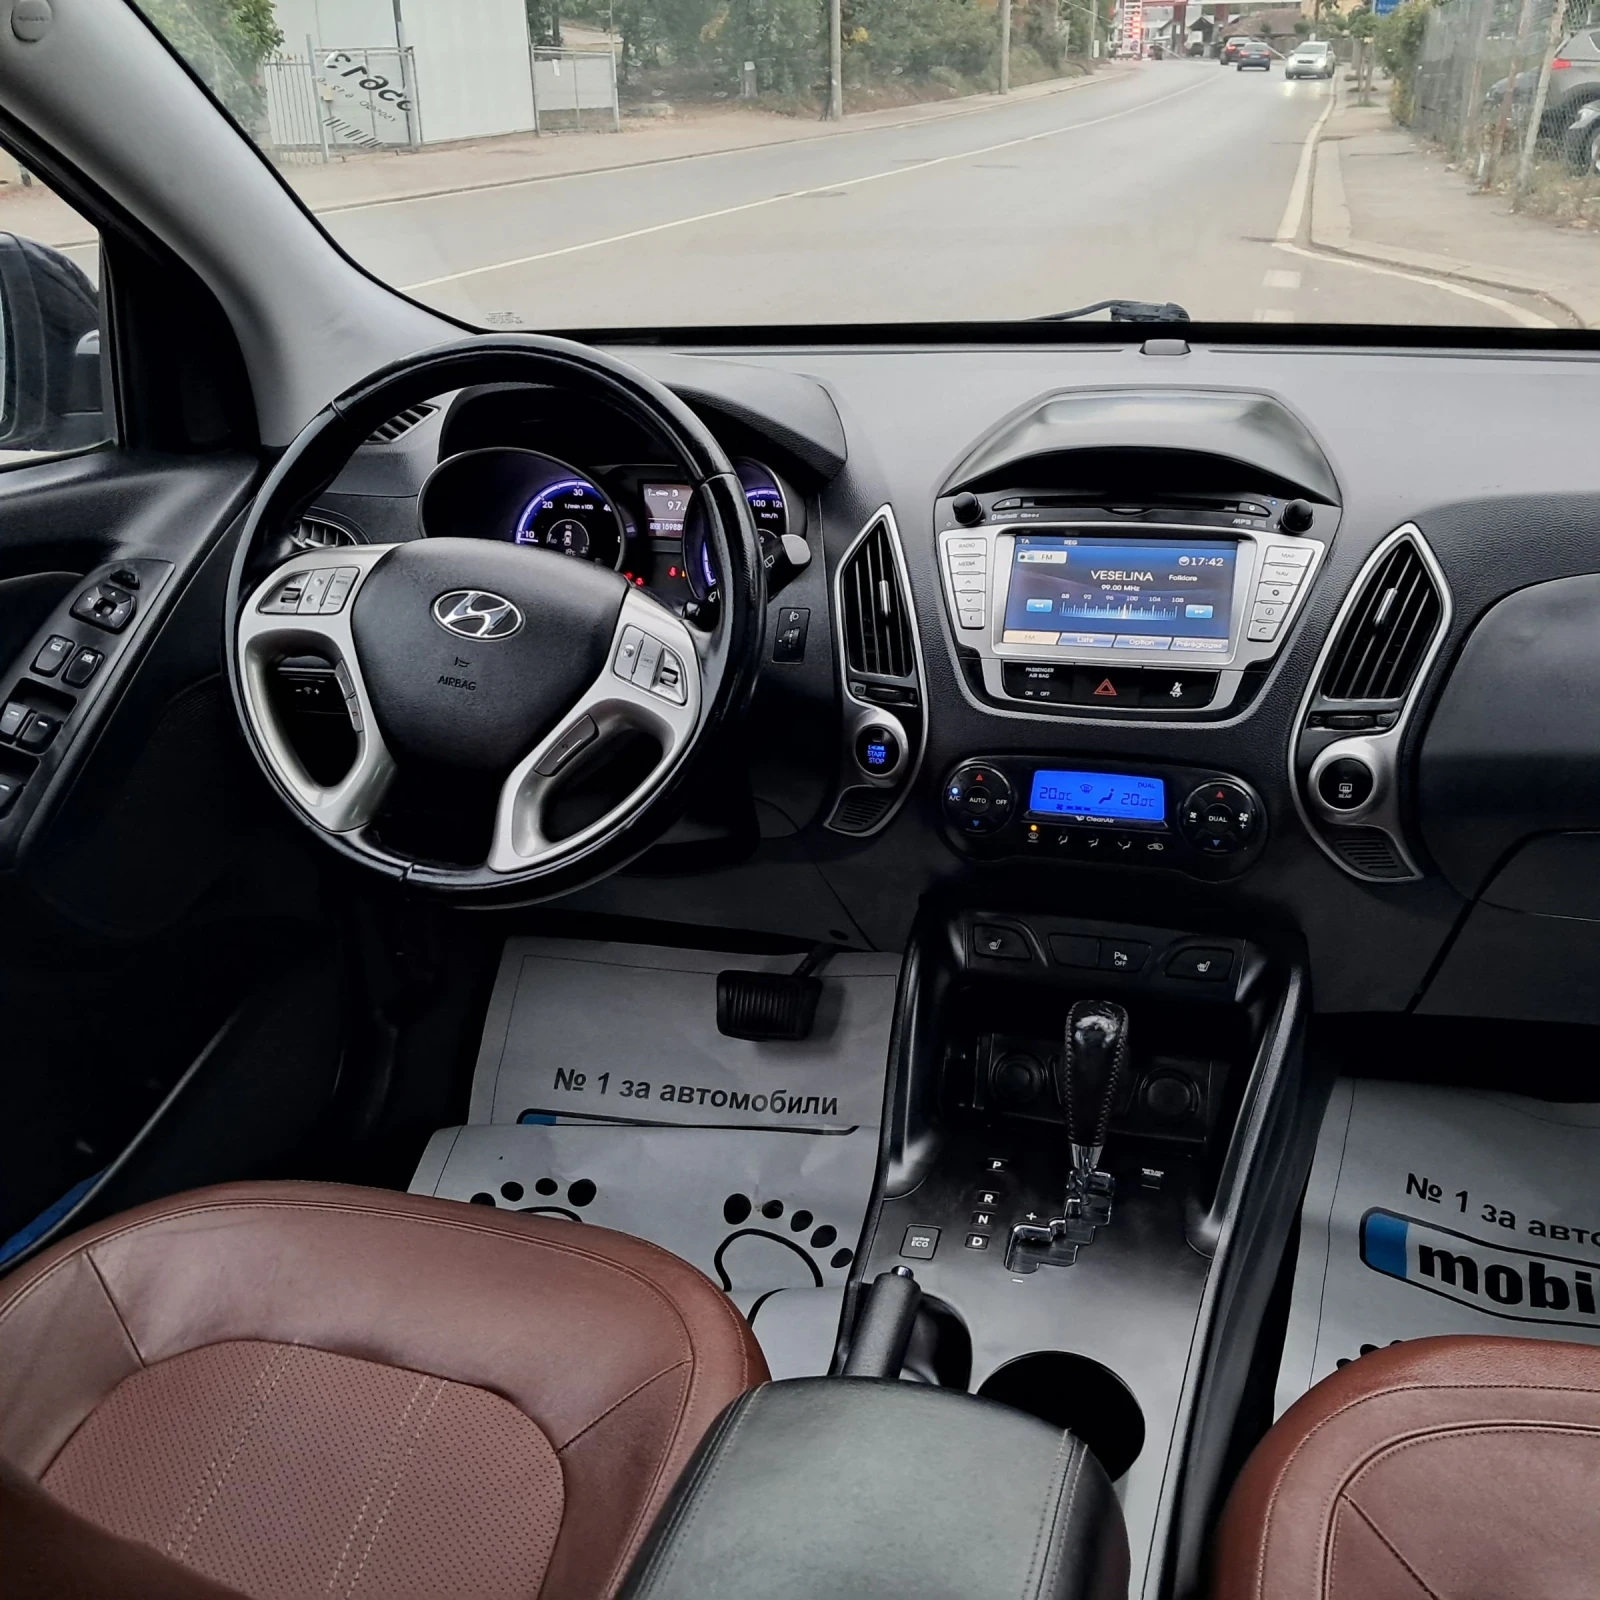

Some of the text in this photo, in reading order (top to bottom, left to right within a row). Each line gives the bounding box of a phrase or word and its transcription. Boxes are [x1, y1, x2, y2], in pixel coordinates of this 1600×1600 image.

[668, 501, 682, 511] 9.7
[1190, 557, 1224, 567] 17:42
[1091, 570, 1154, 582] VESELINA
[1168, 574, 1198, 582] Folklore
[1129, 638, 1155, 646] Option
[438, 675, 477, 691] AIRBAG
[867, 750, 886, 758] START
[1208, 815, 1228, 823] DUAL
[598, 1072, 610, 1095] 1
[619, 1079, 651, 1100] за
[660, 1083, 839, 1116] автомобили
[992, 1161, 1002, 1169] P
[983, 1194, 994, 1203] R
[1455, 1190, 1469, 1213] 1
[1481, 1203, 1516, 1230] за
[978, 1215, 988, 1224] N
[911, 1240, 929, 1248] ECO
[972, 1237, 983, 1246] D
[1418, 1244, 1596, 1315] mobi
